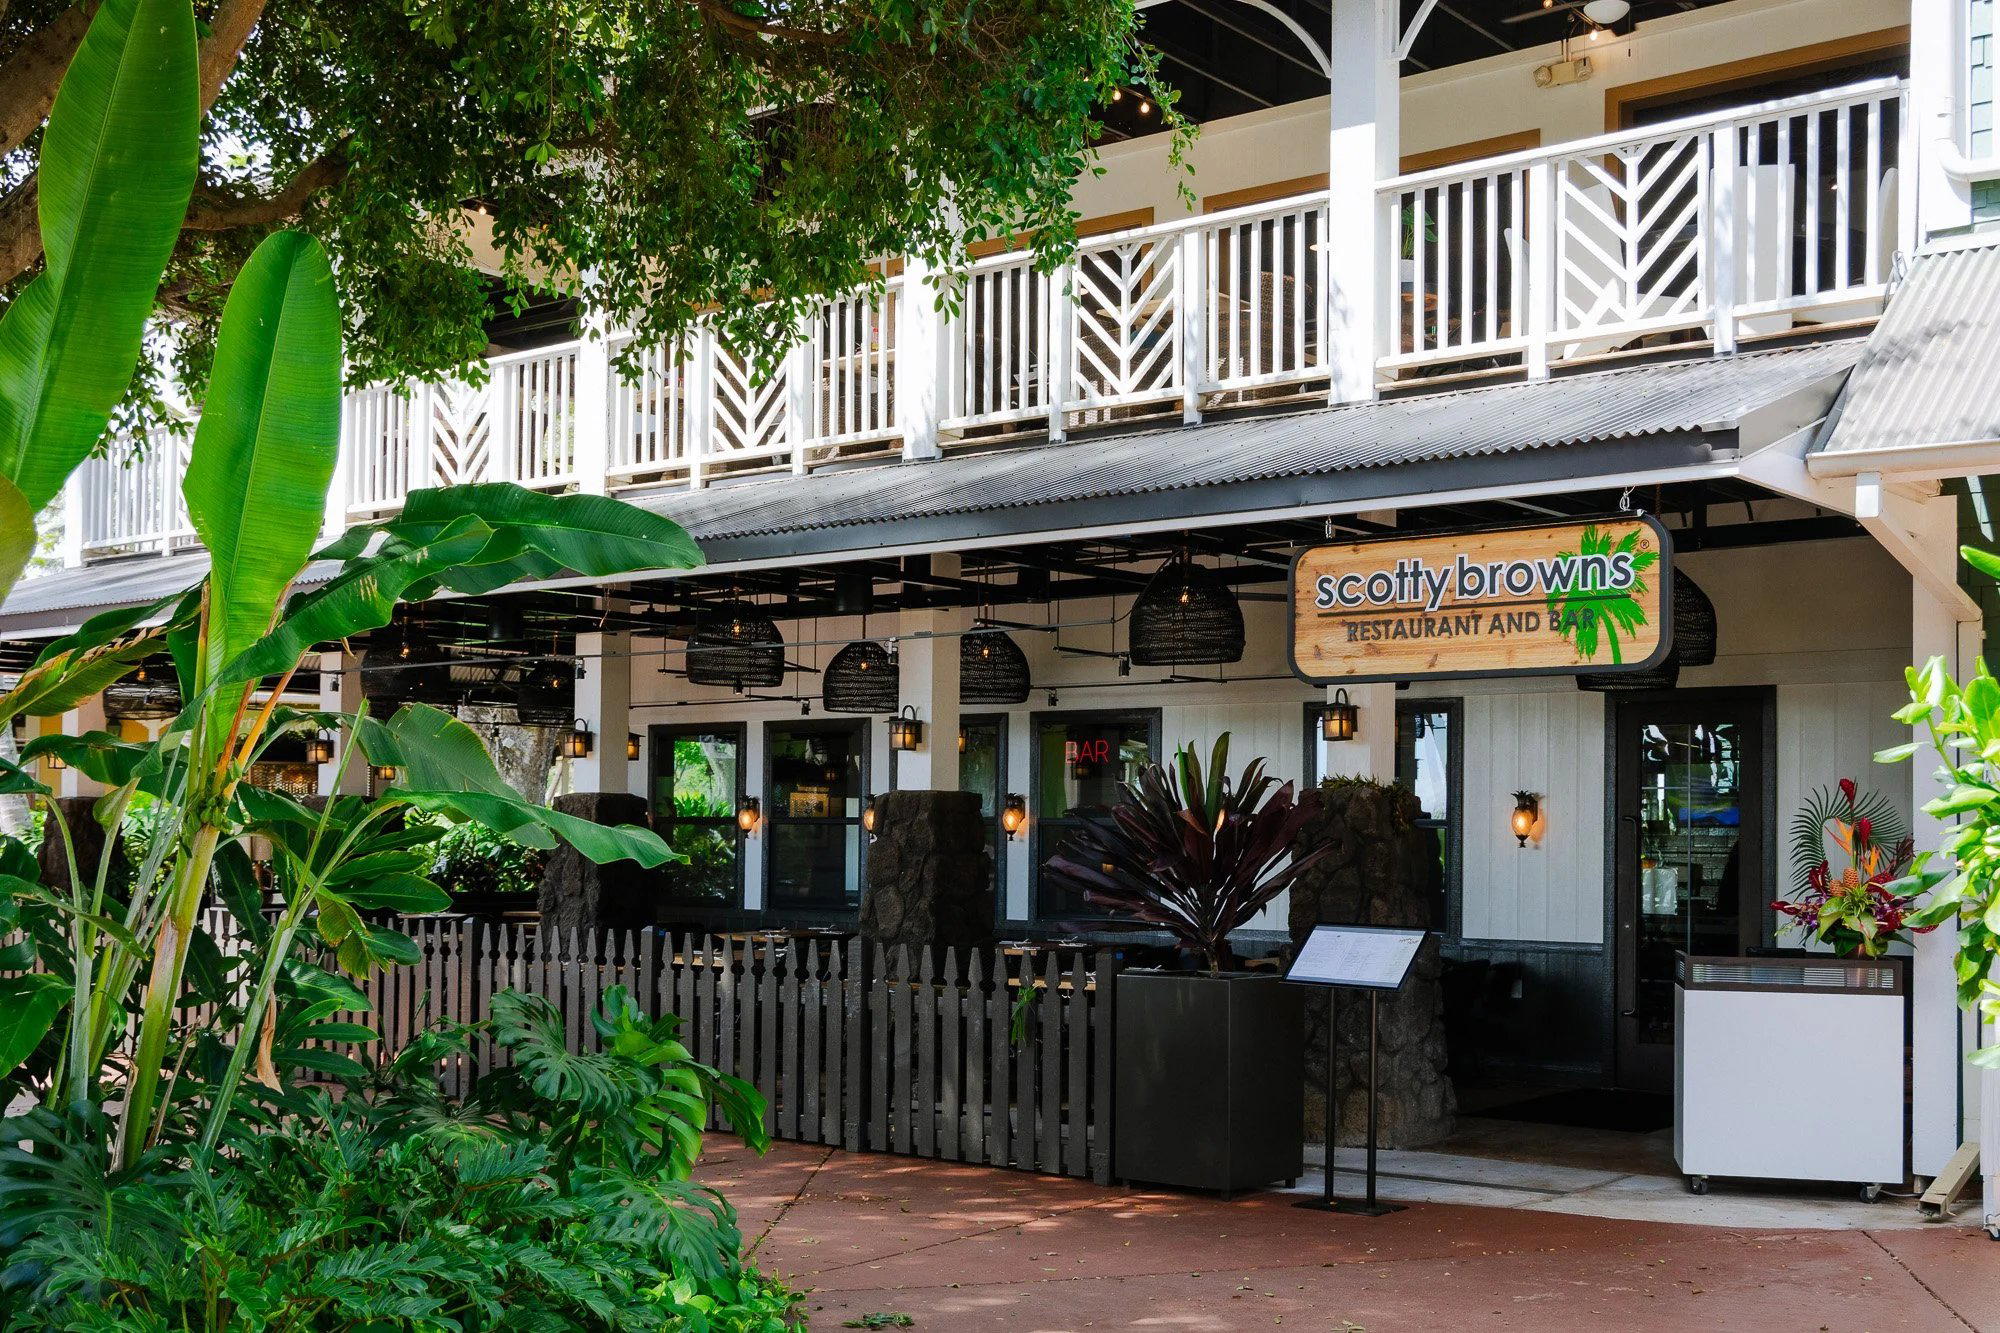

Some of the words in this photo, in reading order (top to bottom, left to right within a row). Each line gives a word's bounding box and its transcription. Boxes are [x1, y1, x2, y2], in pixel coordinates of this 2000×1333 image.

[1347, 614, 1481, 642] RESTAURANT
[1489, 612, 1540, 634] AND
[1549, 609, 1595, 631] BAR
[1065, 740, 1109, 764] BAR
